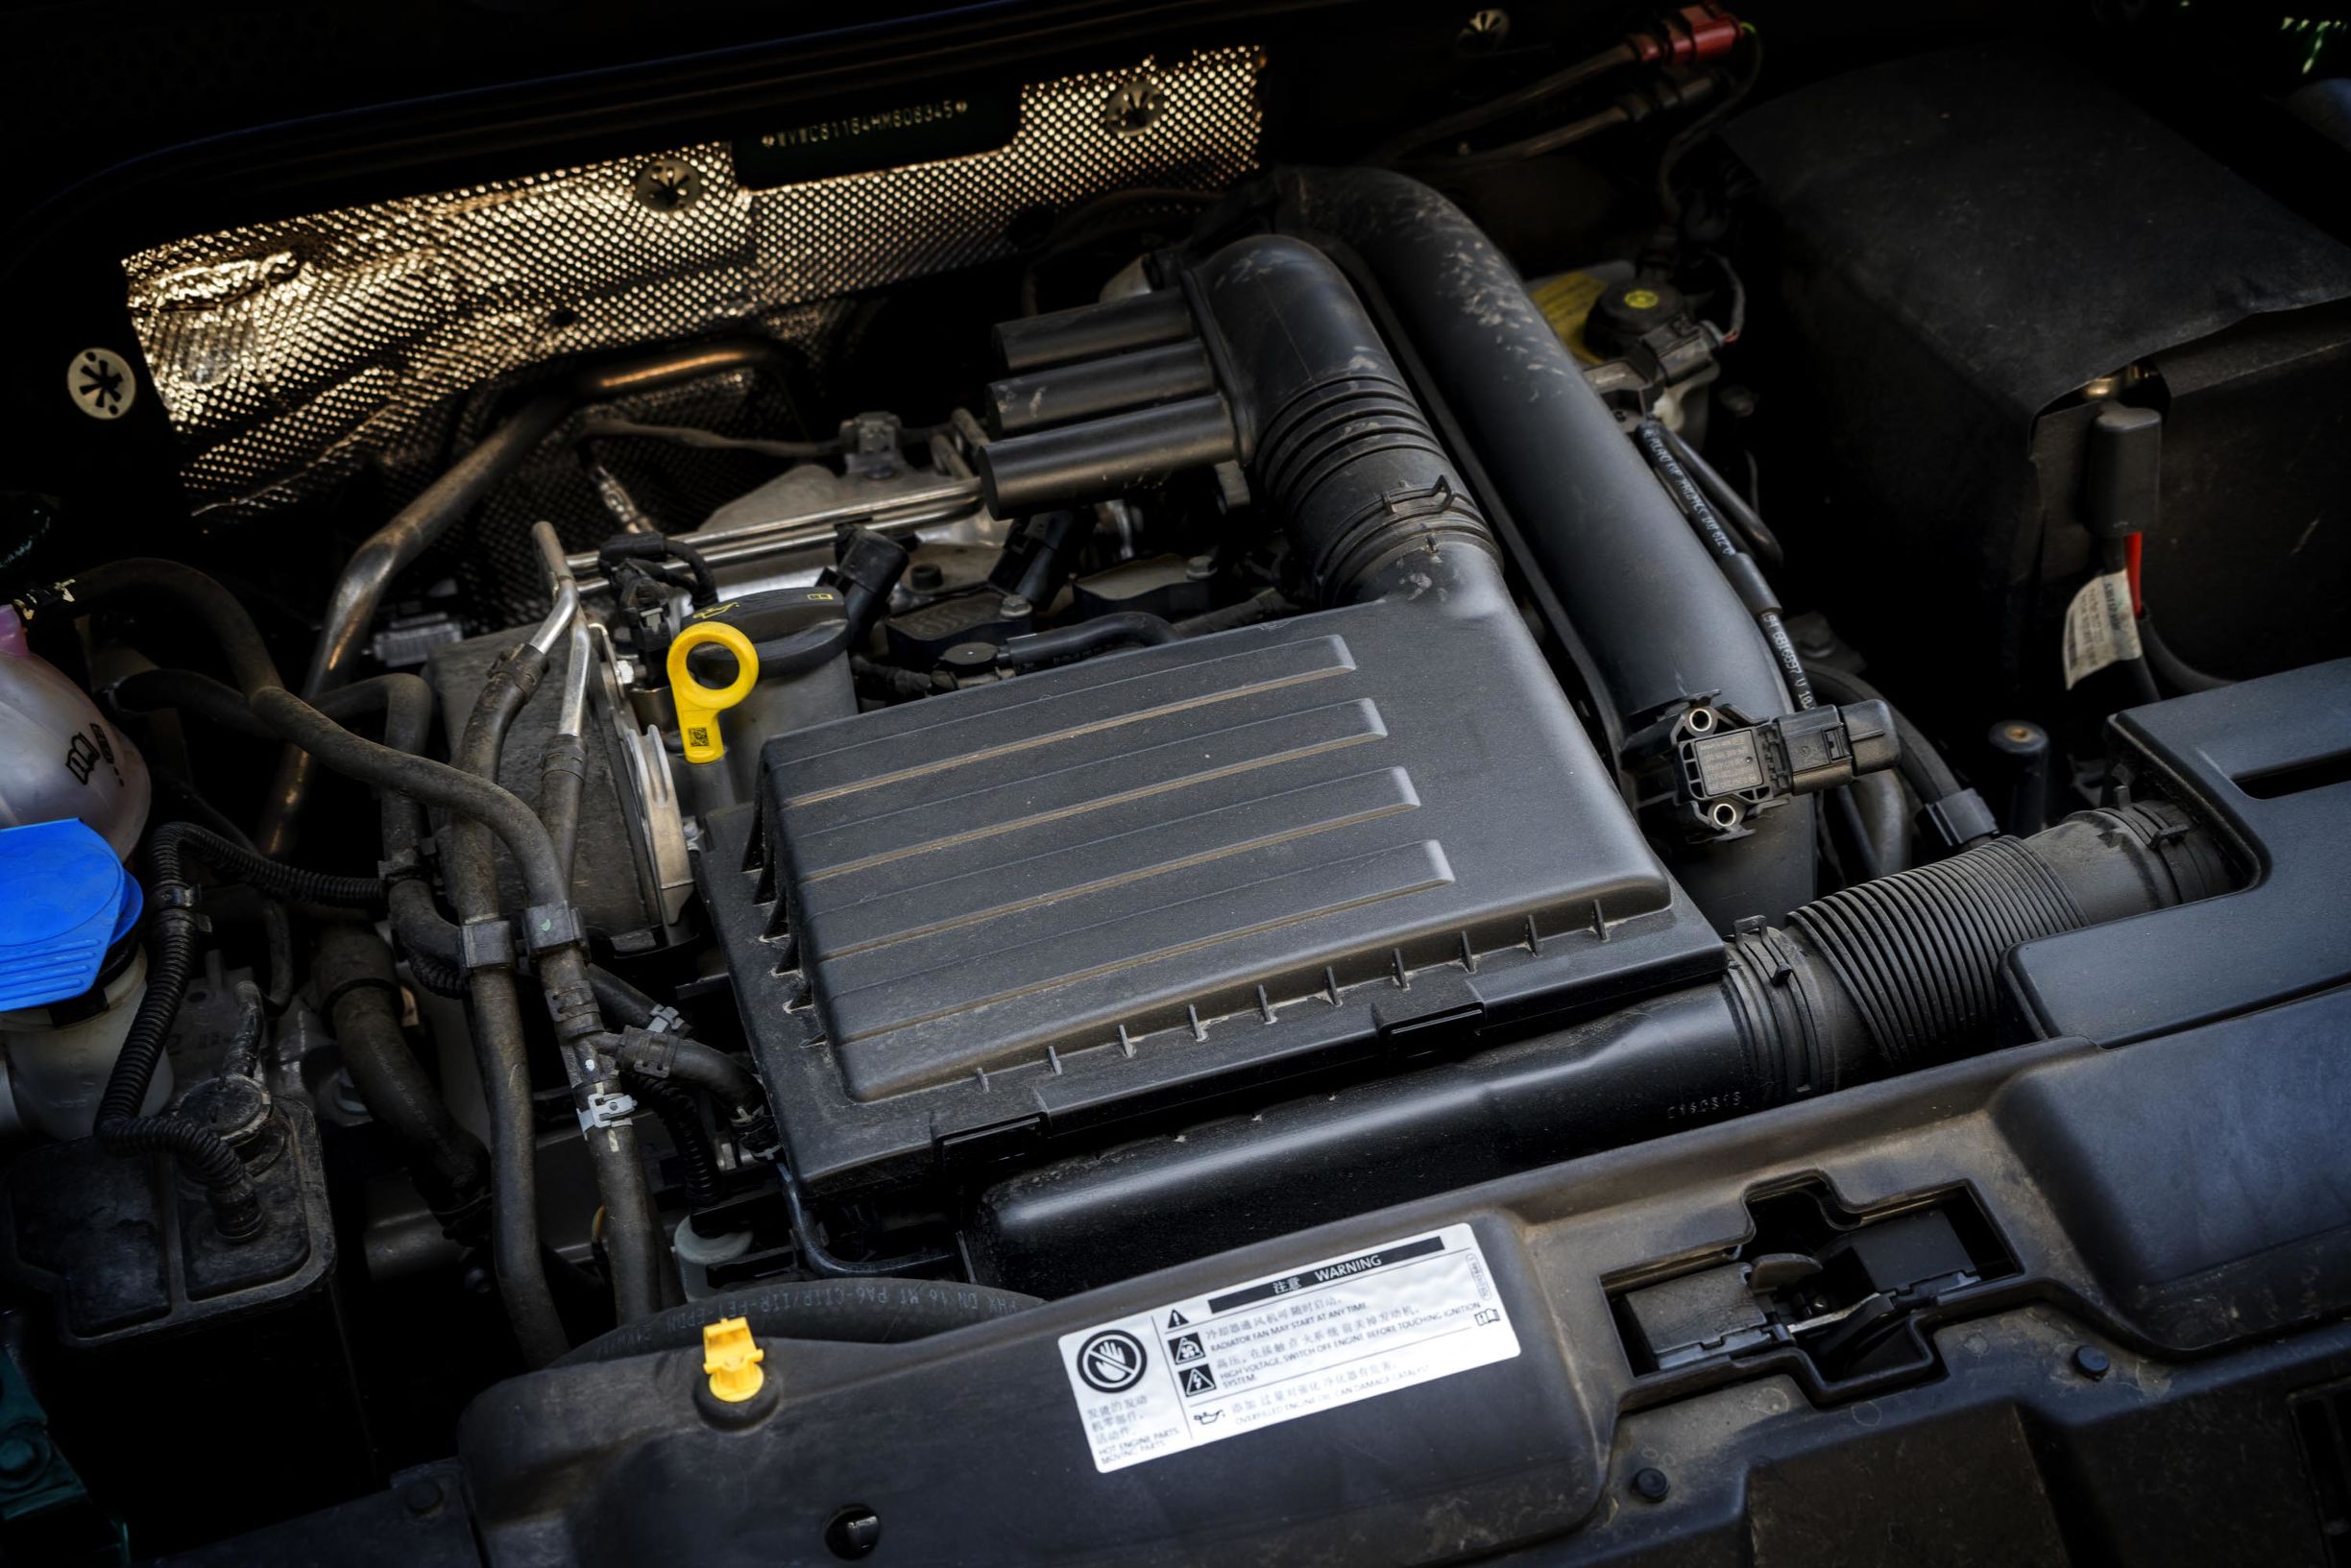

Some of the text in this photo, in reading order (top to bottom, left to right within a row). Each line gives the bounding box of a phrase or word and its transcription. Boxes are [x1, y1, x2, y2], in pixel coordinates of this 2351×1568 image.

[1272, 1254, 1381, 1293] 注意 WARNING
[1210, 1335, 1250, 1351] RADIATOR
[1252, 1330, 1269, 1339] FAN
[1271, 1324, 1290, 1334] MAY
[1292, 1316, 1315, 1328] START
[1327, 1308, 1345, 1317] ANY
[1221, 1368, 1242, 1380] HIGH
[1283, 1347, 1315, 1362] SWITCH
[1317, 1343, 1331, 1352] OFF
[1333, 1334, 1364, 1347] ENGINE
[1367, 1324, 1395, 1338] BEFORE
[1397, 1312, 1442, 1329] TOUCHING
[1443, 1300, 1480, 1315] IGNITION
[1334, 1386, 1352, 1396] CAN
[1353, 1375, 1390, 1390] DAMAGE
[1119, 1435, 1150, 1450] ENGINE
